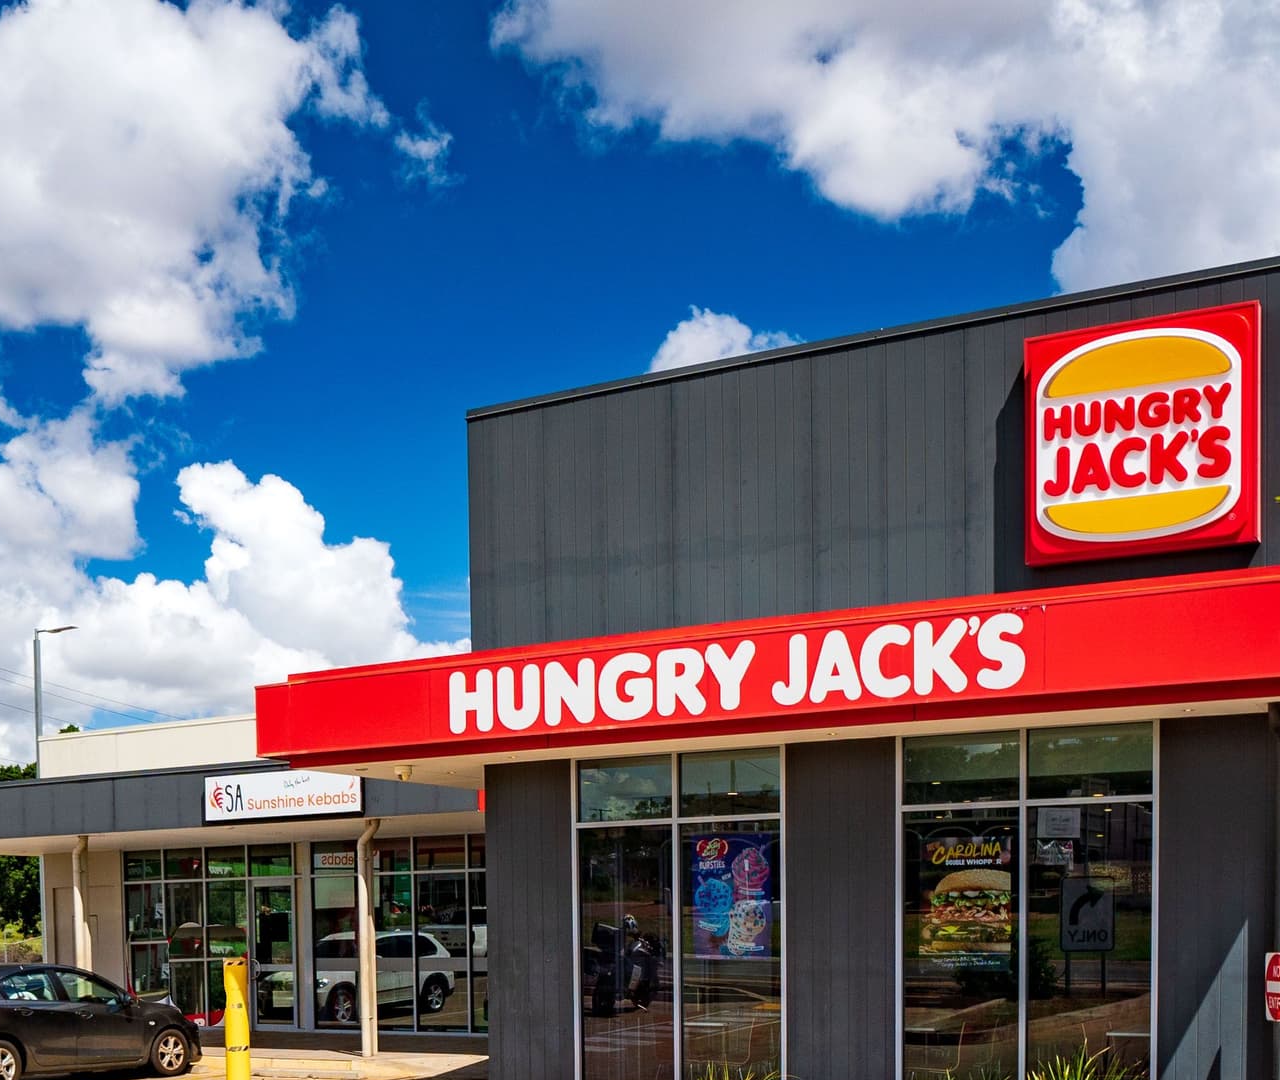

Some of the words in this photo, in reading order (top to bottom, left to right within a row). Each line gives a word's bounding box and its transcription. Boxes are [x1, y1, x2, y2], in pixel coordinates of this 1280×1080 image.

[1043, 382, 1232, 442] HUNGRY
[1043, 426, 1231, 497] JACK'S
[448, 640, 756, 734] HUNGRY
[771, 613, 1026, 706] JACK'S
[225, 784, 243, 813] SA
[247, 794, 304, 811] Sunshine
[307, 791, 357, 807] Kebabs
[931, 841, 1001, 865] CAROLINA
[1273, 965, 1280, 978] NO
